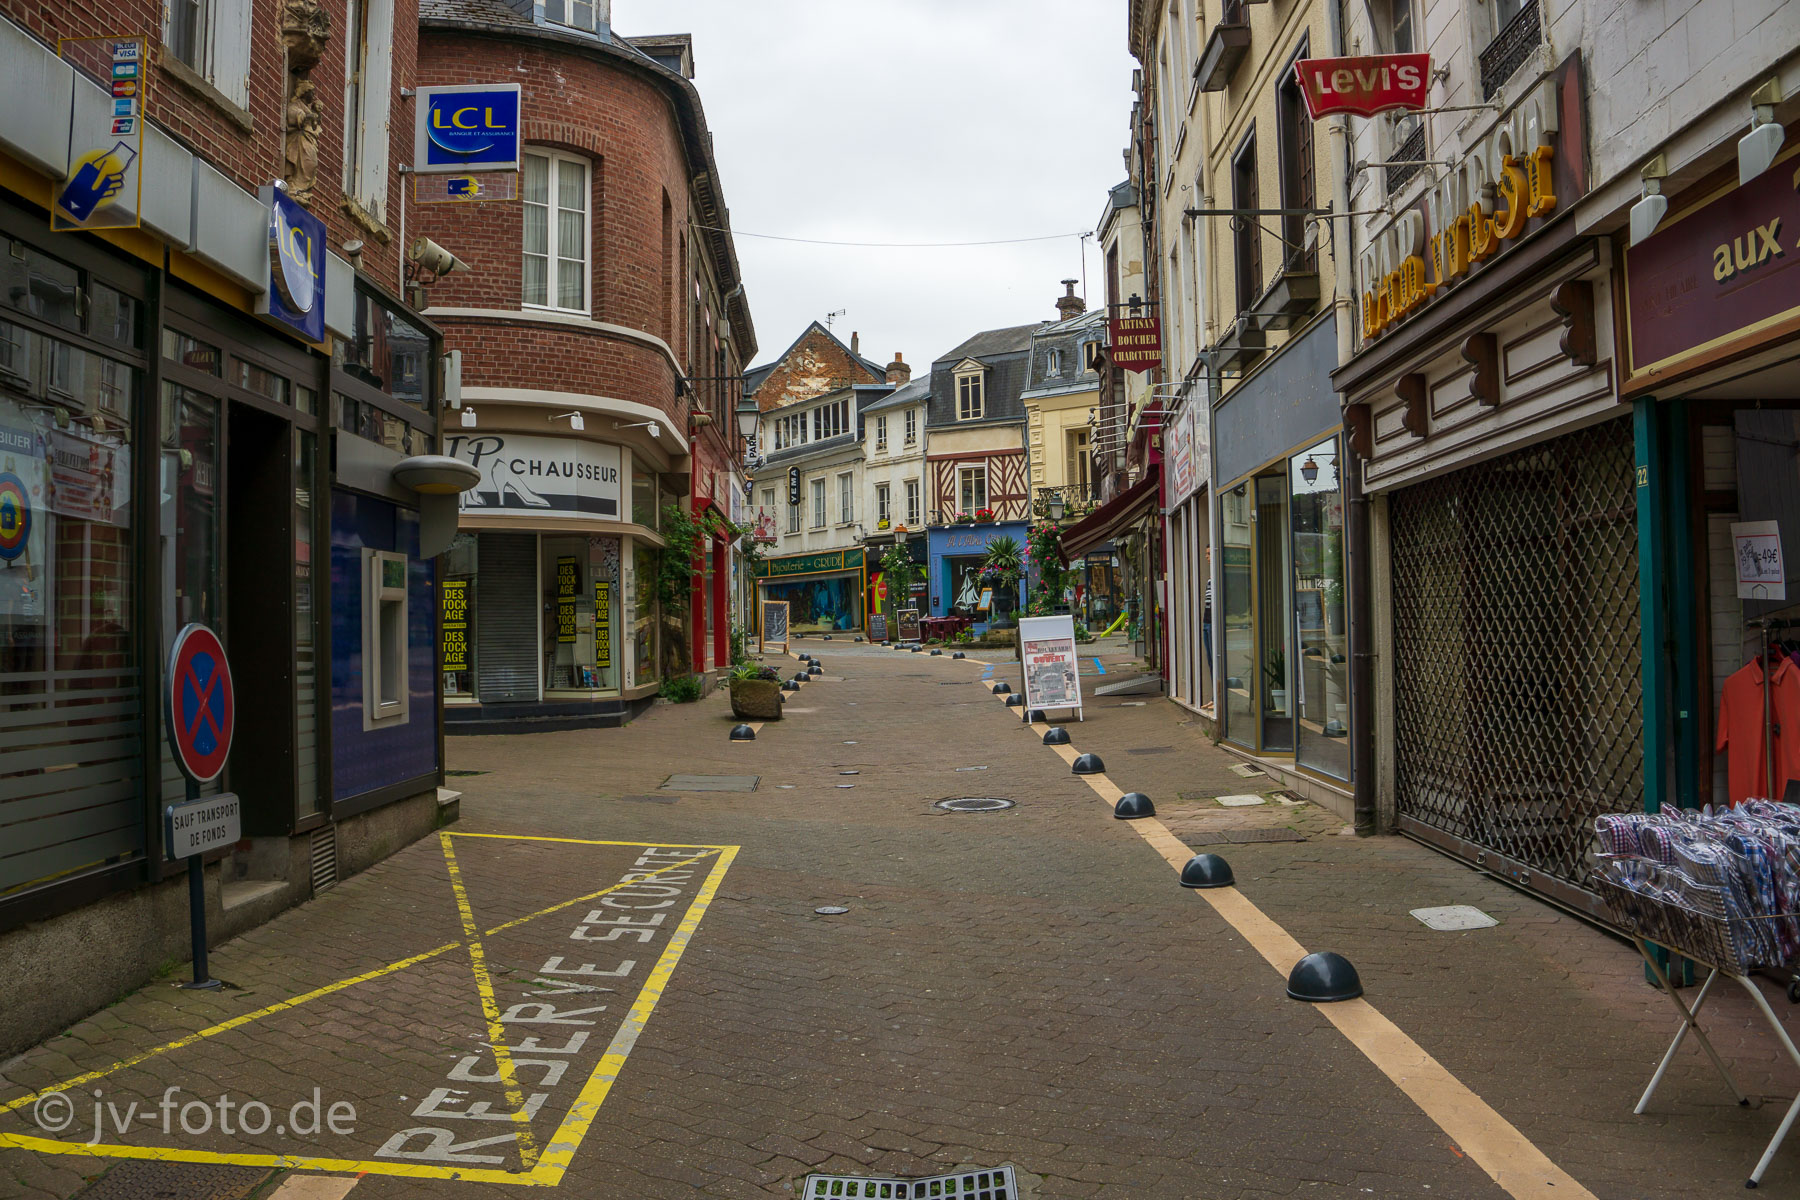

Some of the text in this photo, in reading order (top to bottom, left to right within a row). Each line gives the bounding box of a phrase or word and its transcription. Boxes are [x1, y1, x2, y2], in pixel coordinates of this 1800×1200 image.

[433, 107, 506, 129] LCL
[279, 215, 319, 279] LCL
[1713, 216, 1783, 281] aux
[1119, 319, 1155, 330] ARTISAN
[1118, 334, 1157, 345] BOUCHER
[1113, 350, 1162, 362] CHARCUTIER
[510, 458, 618, 484] CHAUSSEUR
[1638, 468, 1647, 485] 22
[560, 565, 574, 575] DES
[558, 575, 576, 584] TOCK
[560, 584, 574, 594] AGE
[445, 589, 464, 600] DES
[597, 590, 608, 600] DES
[443, 600, 468, 610] TOCK
[560, 605, 574, 614] DES
[596, 600, 608, 610] TOCK
[444, 610, 464, 620] AGE
[558, 615, 576, 624] TOCK
[597, 610, 608, 620] AGE
[560, 625, 574, 634] AGE
[445, 632, 464, 642] DES
[597, 630, 608, 640] DES
[443, 642, 468, 652] TOCK
[596, 640, 609, 649] TOCK
[444, 652, 464, 662] AGE
[597, 650, 609, 659] AGE
[1033, 655, 1065, 663] OUVERT
[174, 802, 238, 830] SAUF TRANSPORT
[190, 825, 226, 847] DE FONDS
